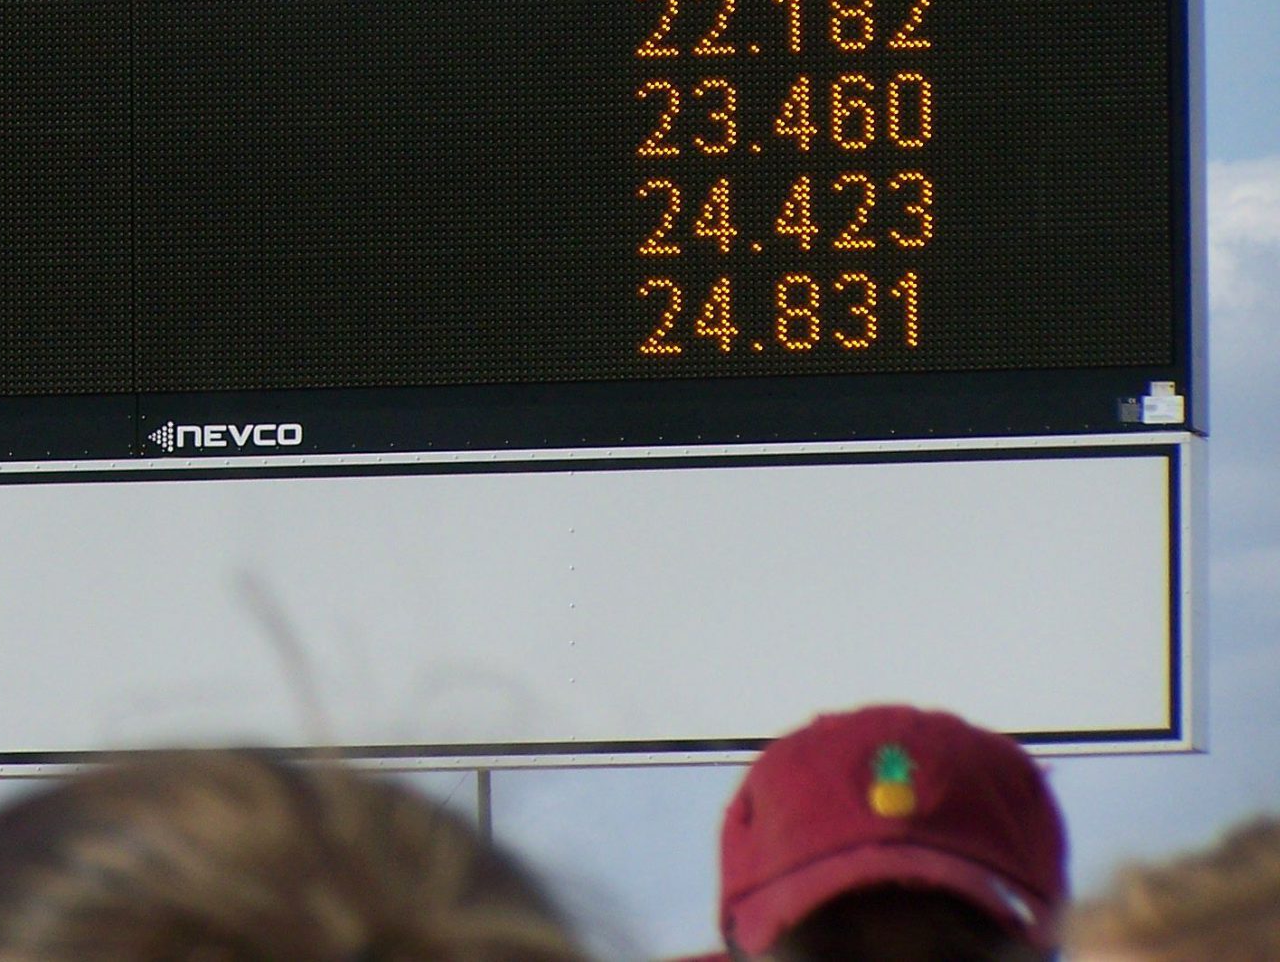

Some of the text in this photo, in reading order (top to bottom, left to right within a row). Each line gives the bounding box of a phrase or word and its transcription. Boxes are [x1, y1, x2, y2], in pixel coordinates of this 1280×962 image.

[638, 73, 933, 156] 23.460
[639, 172, 934, 255] 24.423
[640, 272, 918, 354] 24.831
